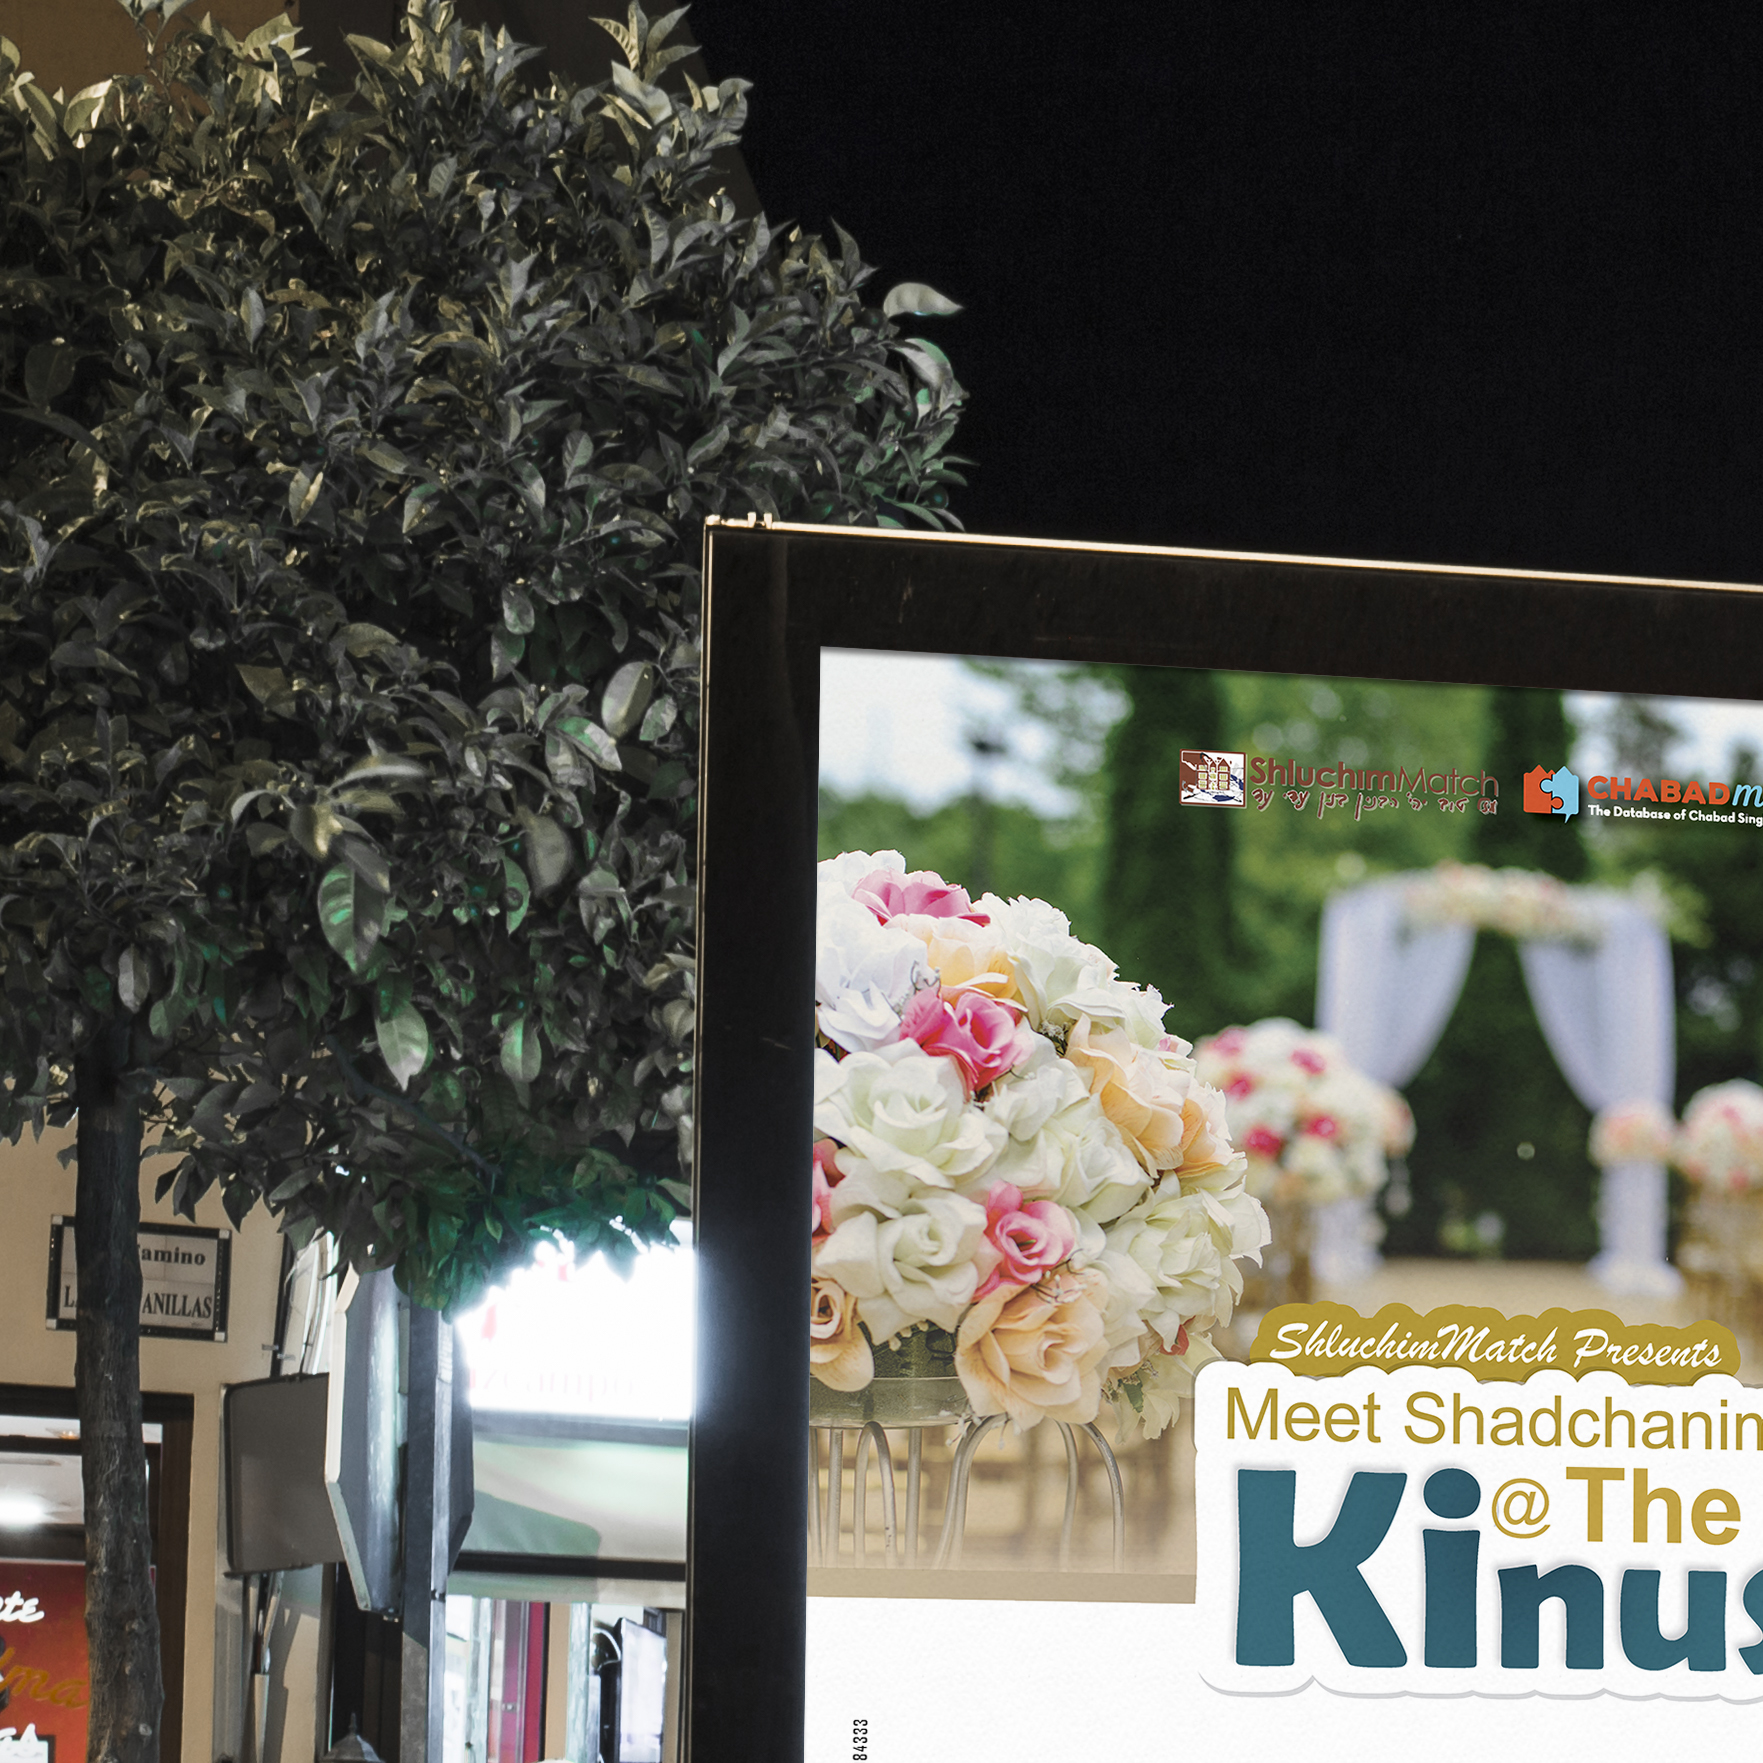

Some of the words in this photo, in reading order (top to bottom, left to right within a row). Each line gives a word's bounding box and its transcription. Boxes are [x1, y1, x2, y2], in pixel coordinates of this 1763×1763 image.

[1250, 757, 1497, 797] ShluchimMatch
[1588, 805, 1610, 816] The
[1614, 806, 1670, 819] Database
[1674, 809, 1686, 819] of
[1689, 811, 1734, 822] Chabad
[138, 1244, 206, 1266] amino
[1270, 1321, 1557, 1362] ShluchimMatch
[1574, 1329, 1721, 1373] Presents
[1227, 1387, 1381, 1443] Meet
[1492, 1478, 1550, 1539] @
[1566, 1467, 1741, 1545] The
